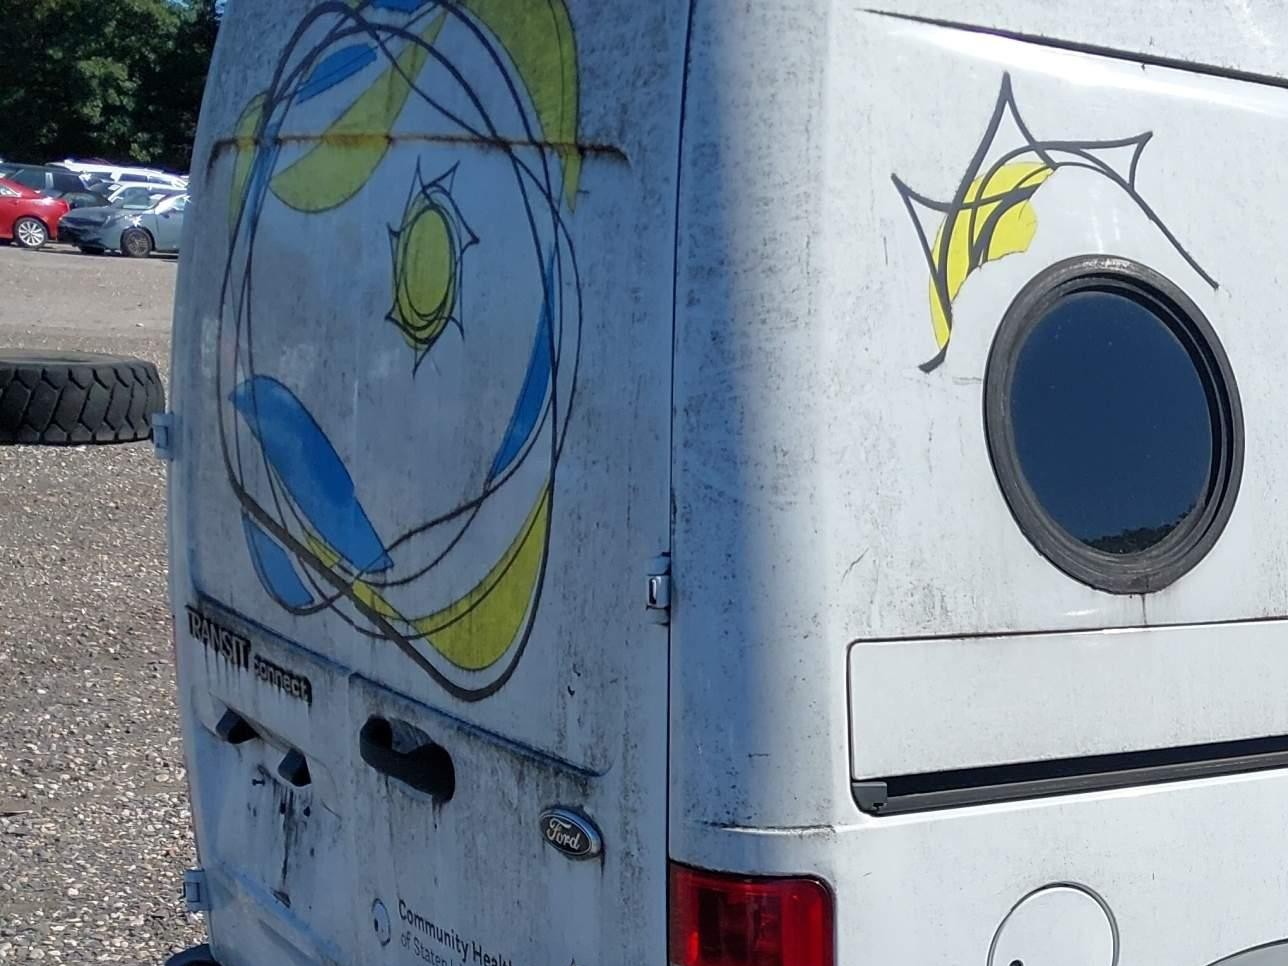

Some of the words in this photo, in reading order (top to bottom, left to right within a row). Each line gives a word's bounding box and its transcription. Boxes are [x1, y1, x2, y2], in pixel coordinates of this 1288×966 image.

[187, 608, 248, 669] TRANSIT
[254, 657, 310, 701] connect
[546, 817, 581, 850] Ford
[398, 899, 469, 964] Community
[401, 931, 411, 950] of
